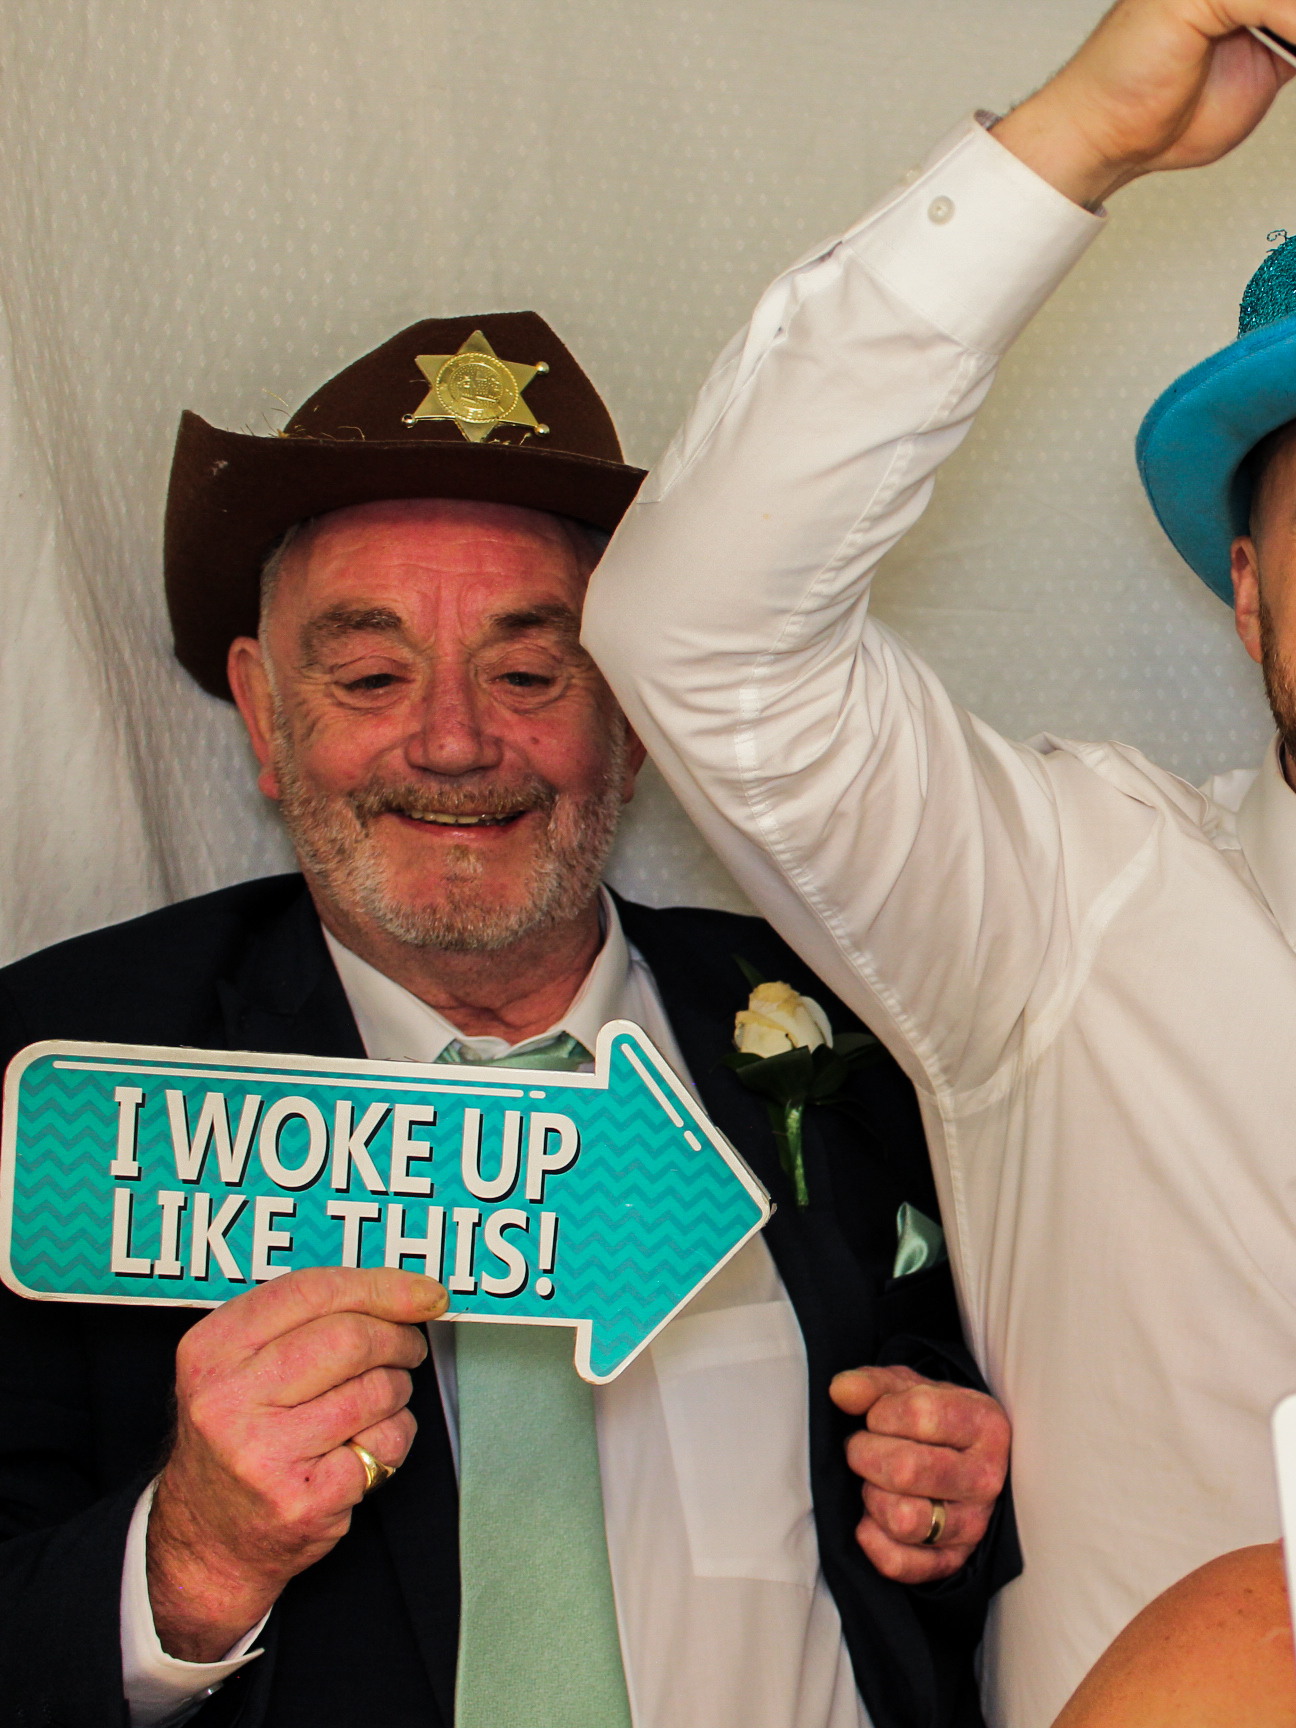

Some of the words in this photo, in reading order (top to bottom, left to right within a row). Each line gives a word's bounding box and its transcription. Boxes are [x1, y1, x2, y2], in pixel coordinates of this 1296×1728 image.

[110, 1086, 148, 1180] I
[165, 1089, 437, 1197] WOKE
[462, 1107, 582, 1203] UP
[110, 1188, 297, 1281] LIKE
[326, 1200, 559, 1300] THIS!
